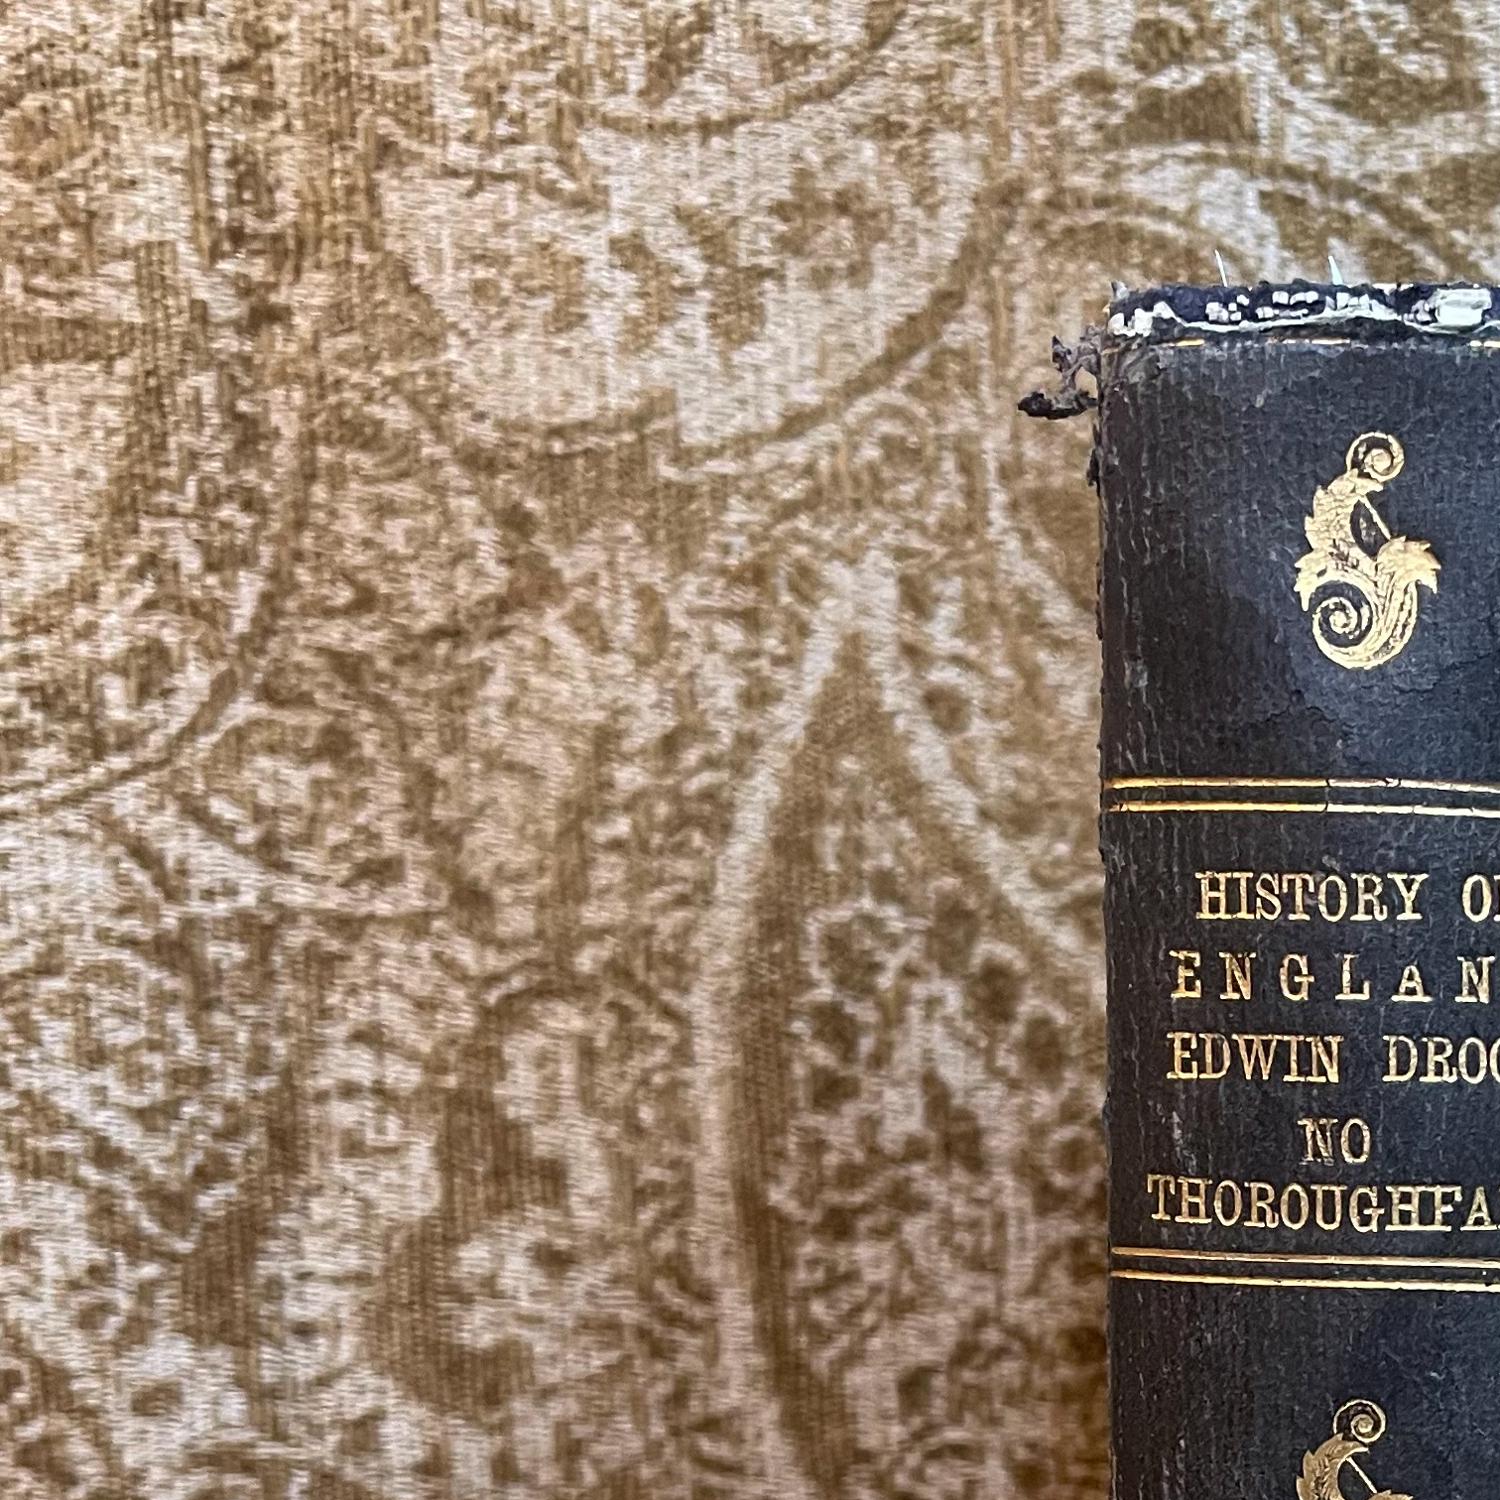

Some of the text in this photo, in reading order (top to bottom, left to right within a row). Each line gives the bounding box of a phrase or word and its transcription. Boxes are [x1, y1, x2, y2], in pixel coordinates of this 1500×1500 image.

[1194, 871, 1430, 922] HISTORY
[1166, 1031, 1345, 1084] EDWIN
[1298, 1117, 1372, 1165] NO
